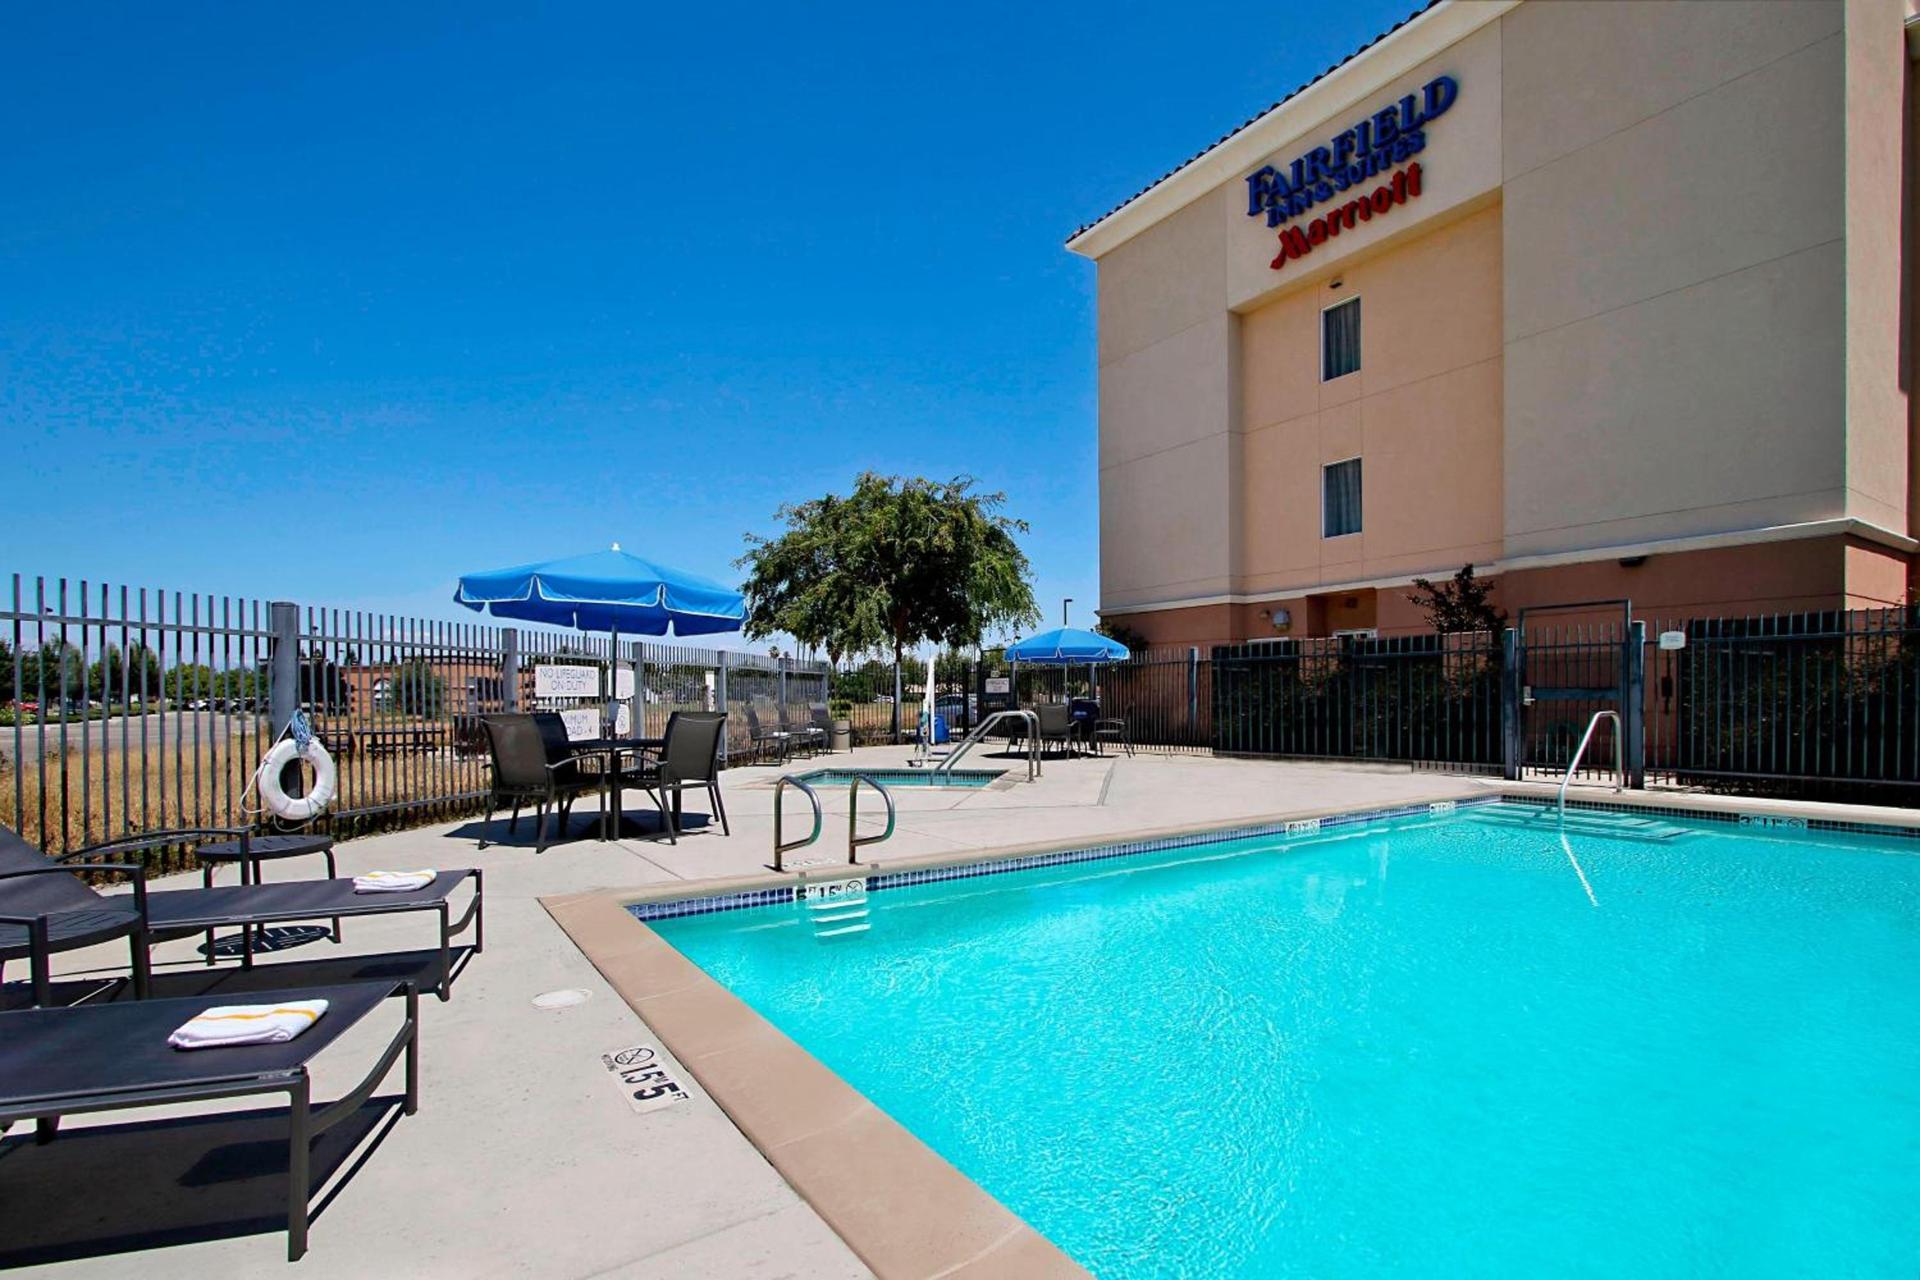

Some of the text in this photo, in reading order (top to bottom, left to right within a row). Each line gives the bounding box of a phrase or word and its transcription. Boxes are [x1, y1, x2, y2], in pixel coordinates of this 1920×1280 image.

[1245, 76, 1458, 216] FAIRFIELD
[1267, 188, 1313, 228] INN
[1334, 131, 1427, 192] SUITES
[1270, 161, 1423, 270] Marriott
[539, 667, 596, 680] NO LIFEGUARD
[551, 680, 587, 691] ON DUTY
